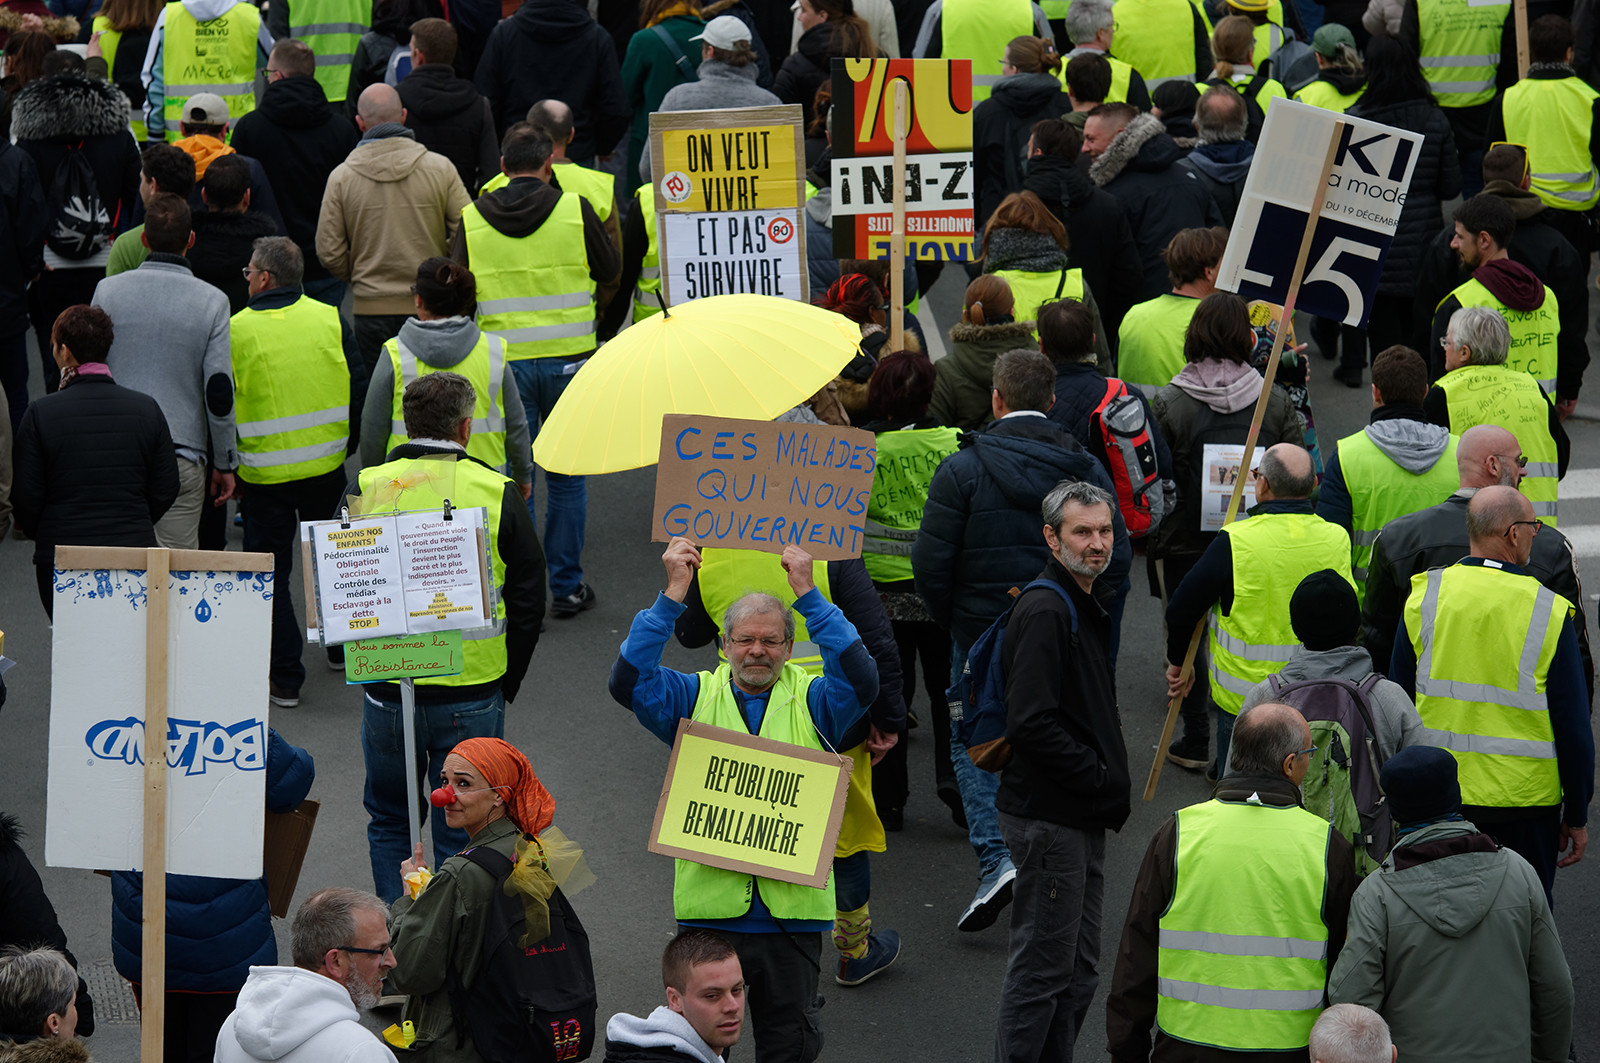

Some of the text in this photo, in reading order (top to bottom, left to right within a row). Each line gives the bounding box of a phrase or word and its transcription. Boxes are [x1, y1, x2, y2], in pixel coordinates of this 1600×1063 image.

[687, 132, 770, 173] ON VEUT
[1334, 123, 1415, 183] KI
[666, 176, 684, 198] FO
[1348, 178, 1408, 206] mode
[702, 176, 759, 212] VIVRE
[1326, 201, 1341, 212] DU
[1343, 205, 1354, 215] 19
[773, 225, 789, 237] 80
[907, 216, 974, 233] ANQUETTES
[697, 216, 767, 257] ET PAS
[686, 258, 784, 300] SURVIVRE
[676, 427, 877, 474] CES MALADES
[697, 467, 870, 516] QUI NOUS
[422, 522, 444, 530] Quand
[663, 504, 864, 553] GOUVERNENT
[328, 528, 383, 541] SAUVONS NOS
[401, 530, 449, 540] gouvernement
[440, 535, 465, 543] Peuple,
[336, 539, 372, 549] ENFANTS
[413, 545, 458, 554] l'insurrection
[324, 545, 390, 560] Pédocriminalité
[412, 554, 437, 563] devient
[447, 553, 461, 561] plus
[336, 558, 380, 570] Obligation
[412, 563, 430, 571] sacré
[448, 560, 462, 569] plus
[339, 568, 379, 579] vaccinale
[408, 569, 455, 580] indispensable
[334, 577, 387, 590] Contrôle des
[422, 579, 449, 587] devoirs.
[347, 589, 377, 599] médias
[333, 600, 375, 611] Esclavage
[352, 609, 375, 619] dette
[349, 620, 372, 629] STOP
[350, 635, 450, 652] Nous sommes la
[354, 650, 455, 676] Résistance !
[705, 756, 805, 810] REPUBLIQUE
[683, 801, 804, 857] BENALLANIÈRE
